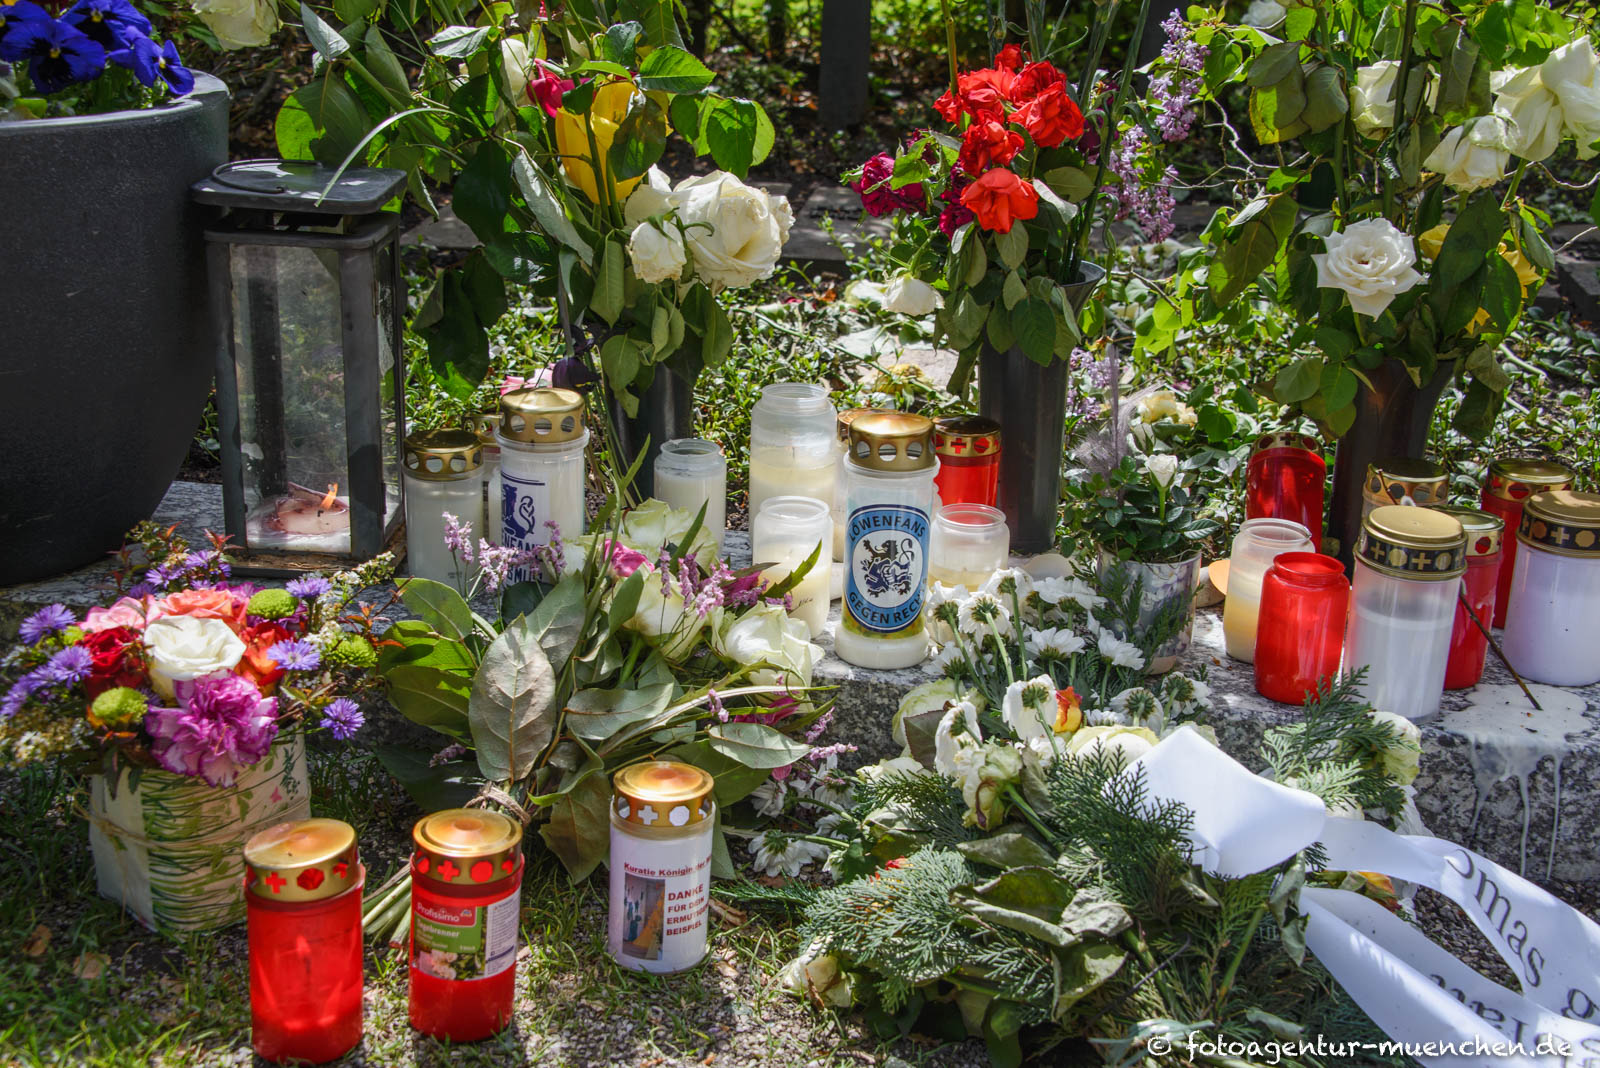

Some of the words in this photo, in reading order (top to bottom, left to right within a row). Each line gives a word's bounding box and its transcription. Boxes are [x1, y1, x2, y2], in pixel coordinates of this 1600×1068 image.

[848, 515, 926, 541] LÖWENFANS
[849, 591, 890, 624] GEGEN
[624, 862, 656, 876] Kuratie
[659, 865, 693, 877] Königin
[668, 883, 704, 901] DANKE
[417, 902, 460, 922] Profissimo
[668, 903, 687, 913] FÜR
[666, 921, 702, 936] BEISPIEL
